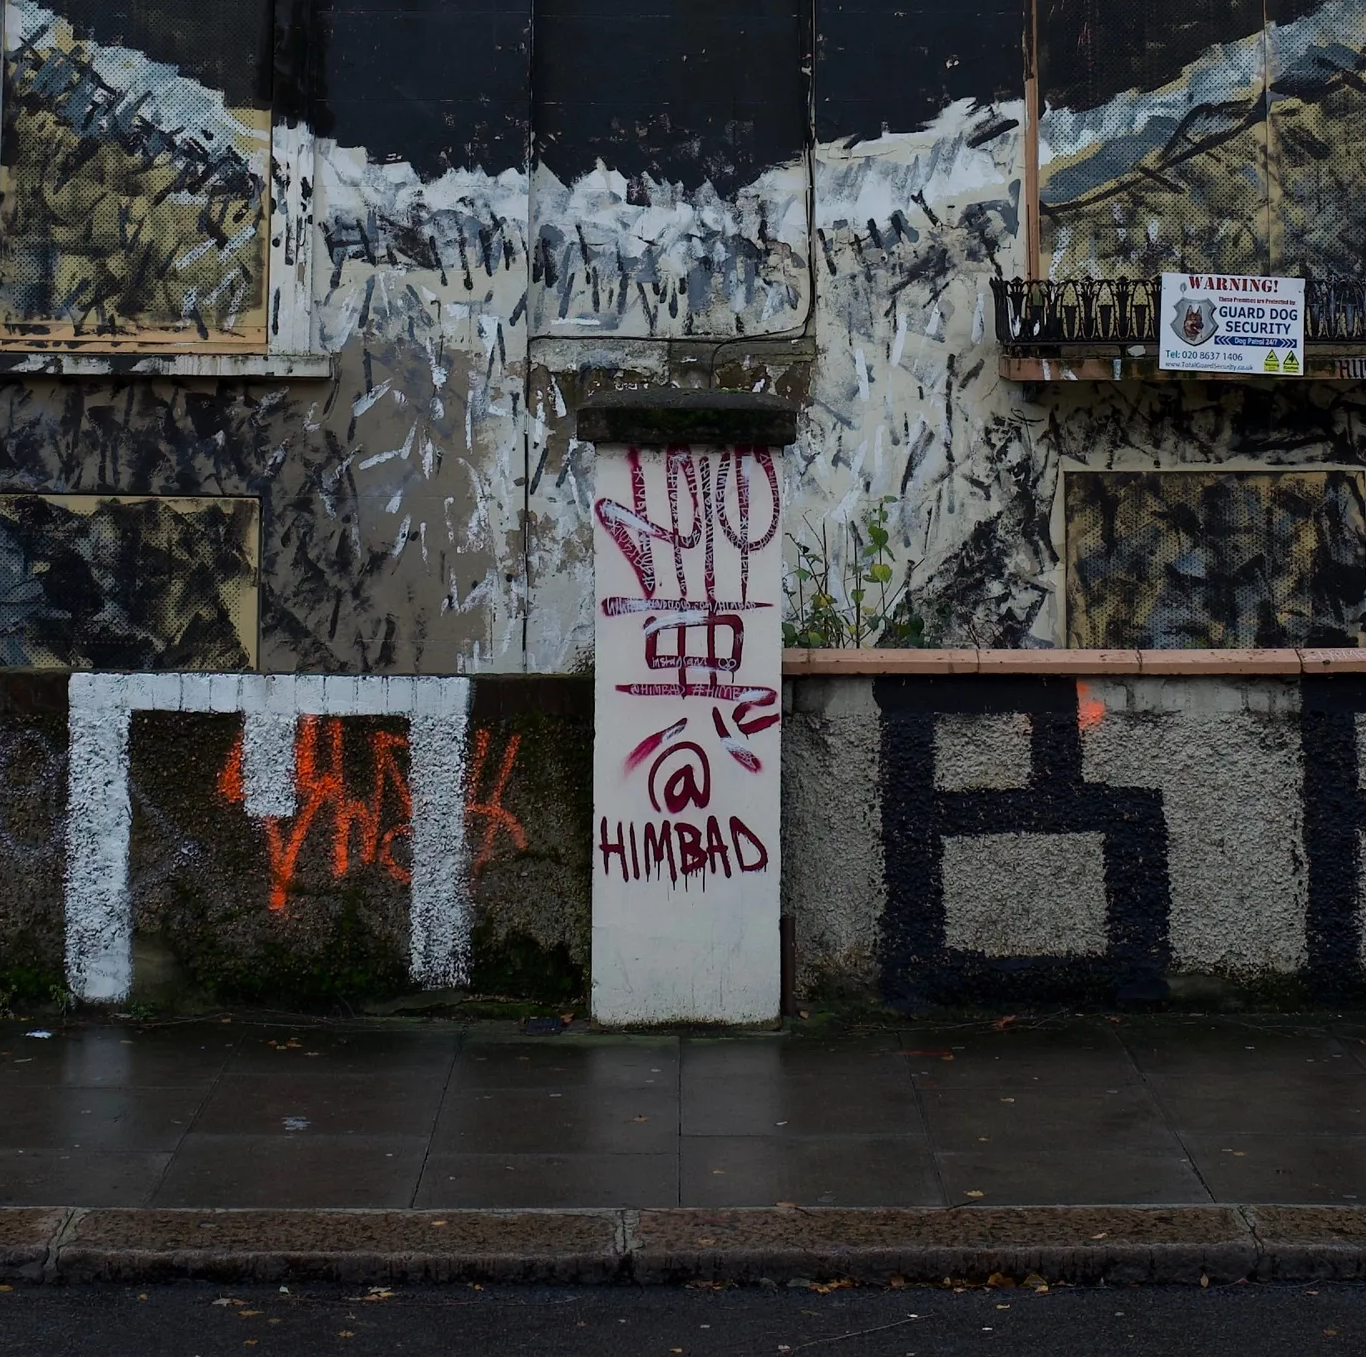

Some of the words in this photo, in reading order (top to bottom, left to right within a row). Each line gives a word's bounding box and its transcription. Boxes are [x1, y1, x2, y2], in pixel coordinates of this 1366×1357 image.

[1188, 276, 1279, 293] WARNING!
[1219, 306, 1265, 319] GUARD
[1270, 308, 1298, 321] DOG
[1225, 321, 1291, 335] SECURITY
[1165, 350, 1181, 359] Tel:
[1182, 351, 1197, 359] 020
[1199, 352, 1220, 360] 8637
[1223, 352, 1243, 361] 1406
[600, 815, 769, 886] HIMBAD
